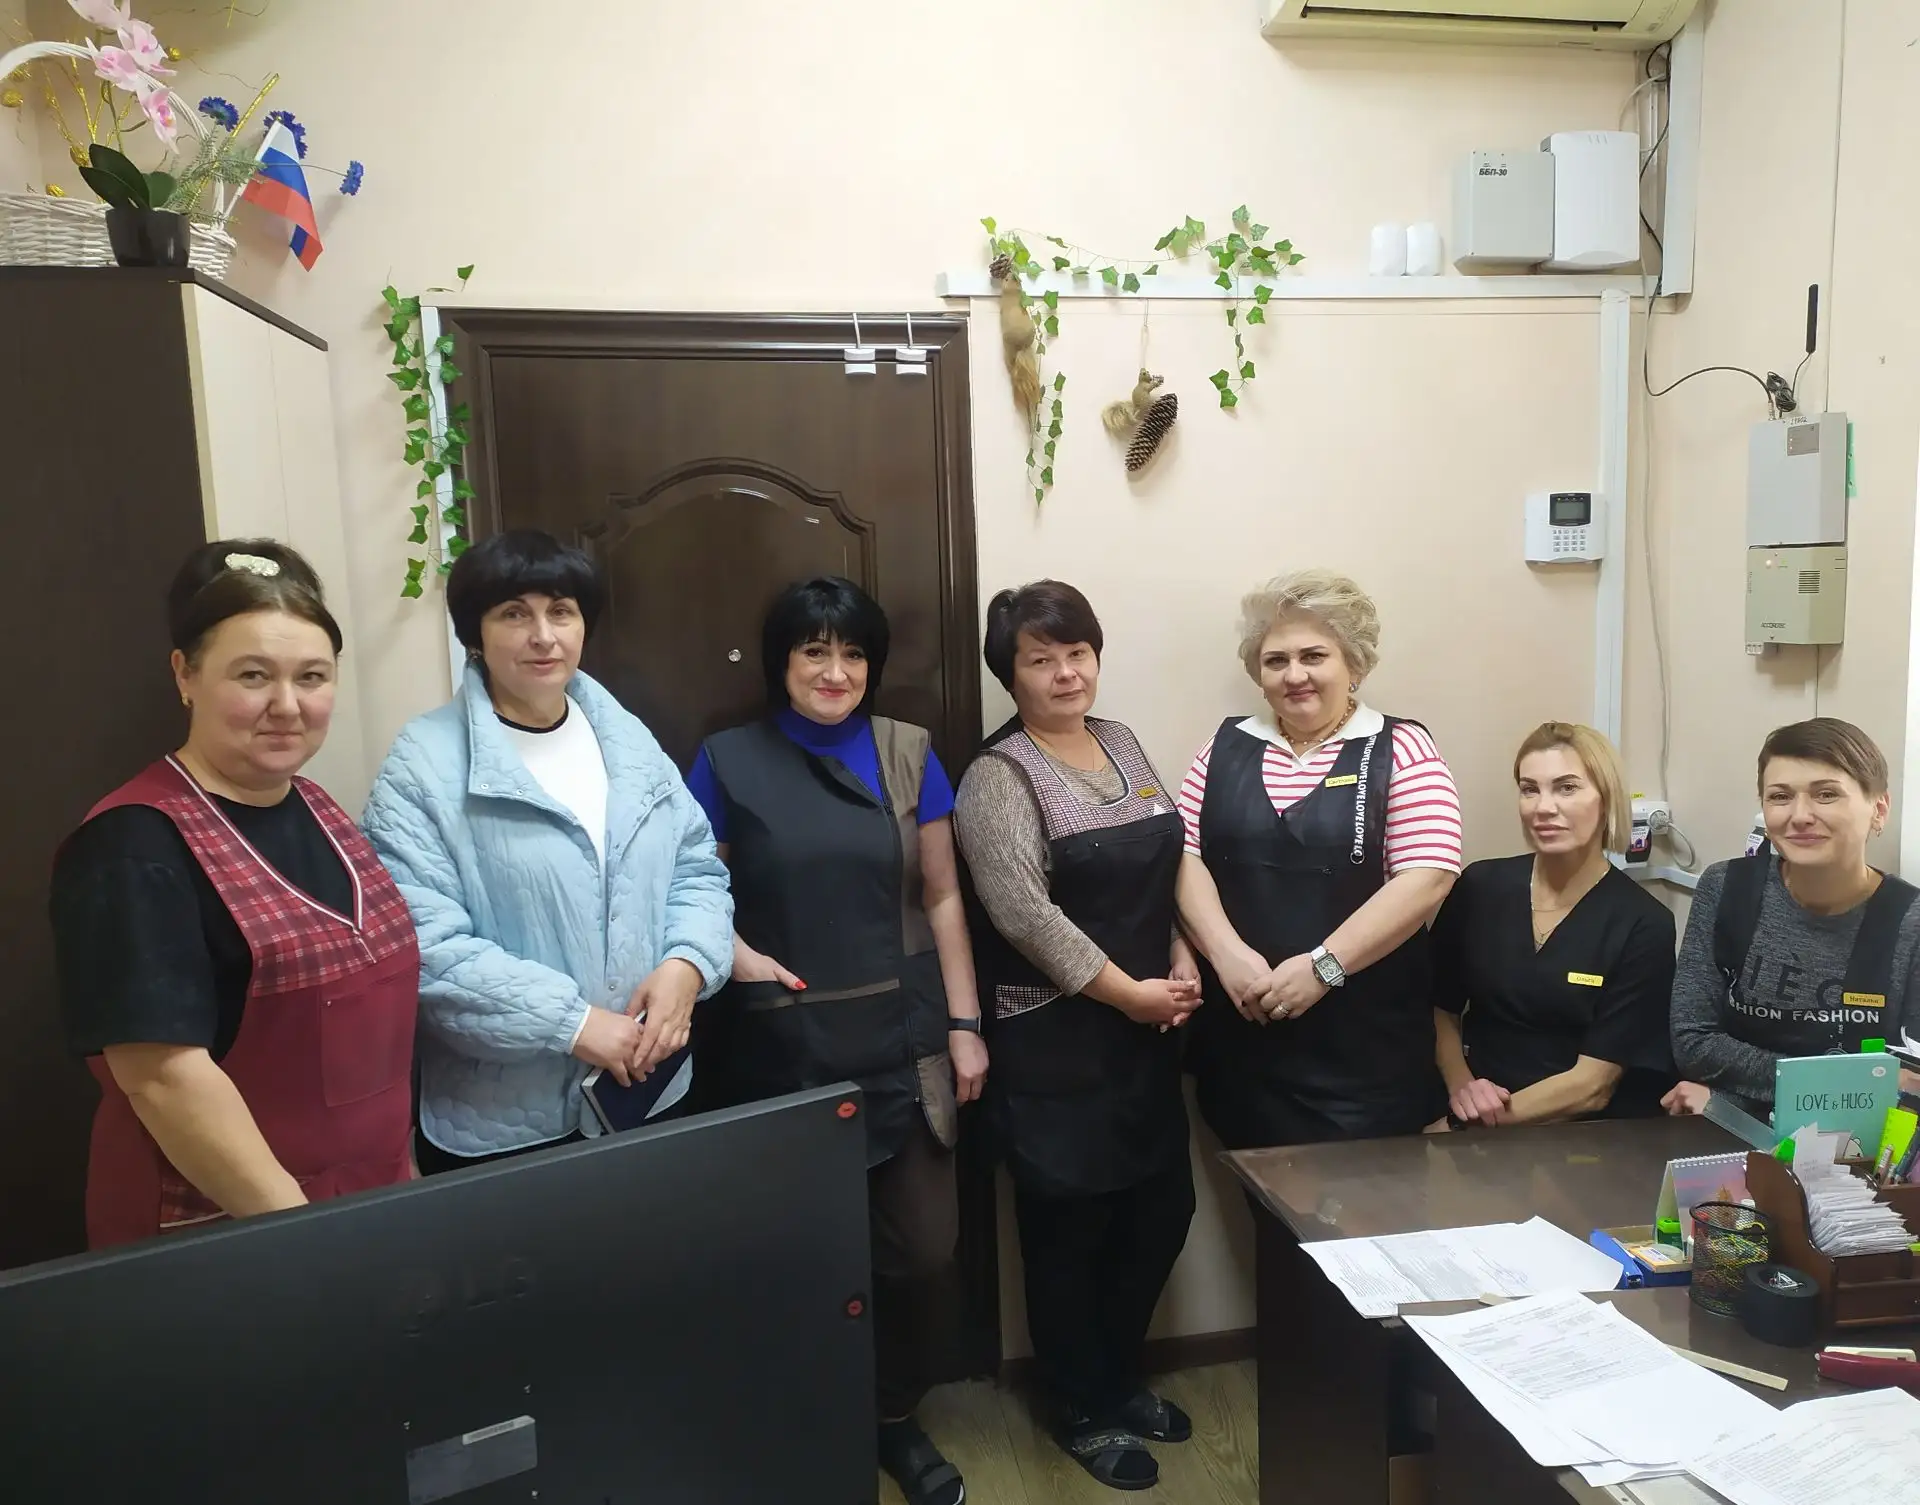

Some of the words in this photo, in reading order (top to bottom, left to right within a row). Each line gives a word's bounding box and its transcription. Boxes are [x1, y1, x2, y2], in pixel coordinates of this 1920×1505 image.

[1479, 168, 1508, 176] ББП-30
[1359, 762, 1369, 780] LOVE
[1356, 780, 1367, 800] LOVE
[1355, 800, 1365, 821] LOVE
[1354, 821, 1365, 844] LOVE
[1792, 1009, 1880, 1024] FASHION
[1796, 1093, 1829, 1112] LOVE
[1841, 1092, 1874, 1110] HUGS
